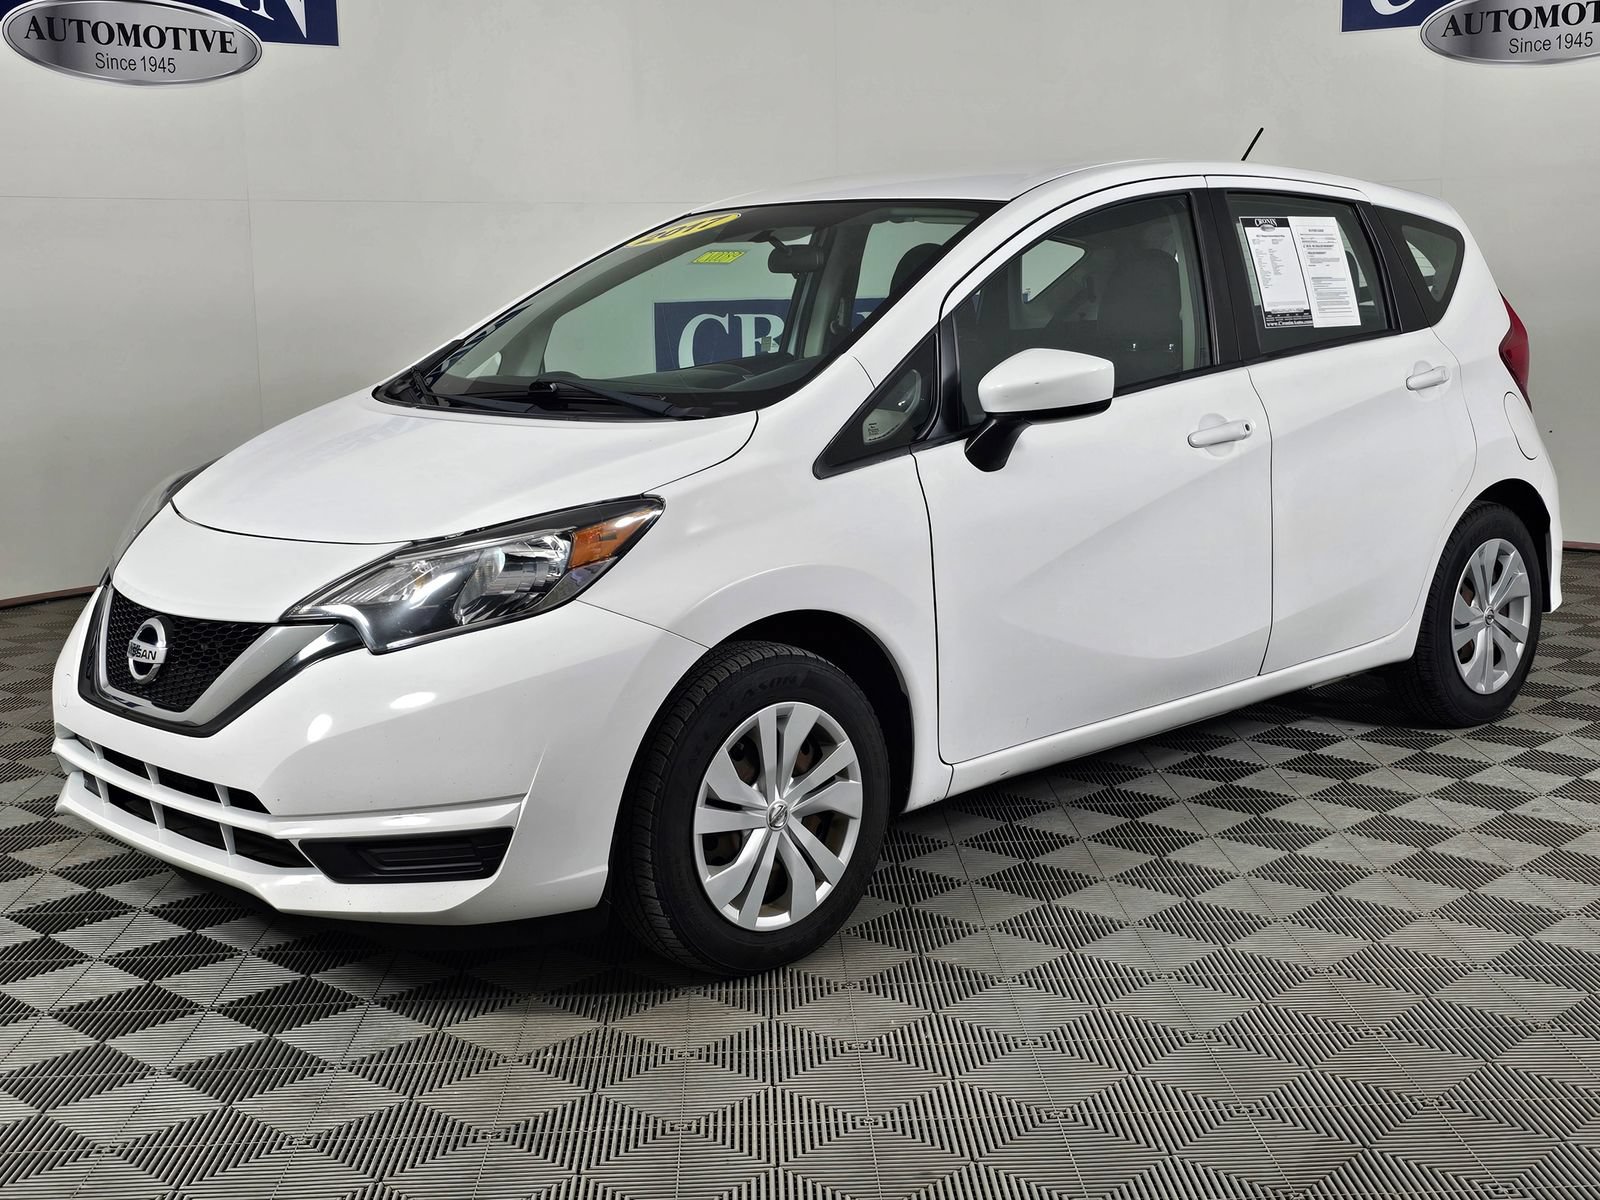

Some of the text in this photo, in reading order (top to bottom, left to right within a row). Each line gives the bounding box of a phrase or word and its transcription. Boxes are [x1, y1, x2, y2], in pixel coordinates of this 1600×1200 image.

[24, 15, 238, 54] AUTOMOTIVE
[1508, 31, 1594, 54] Since 1945
[95, 51, 176, 74] Since 1945
